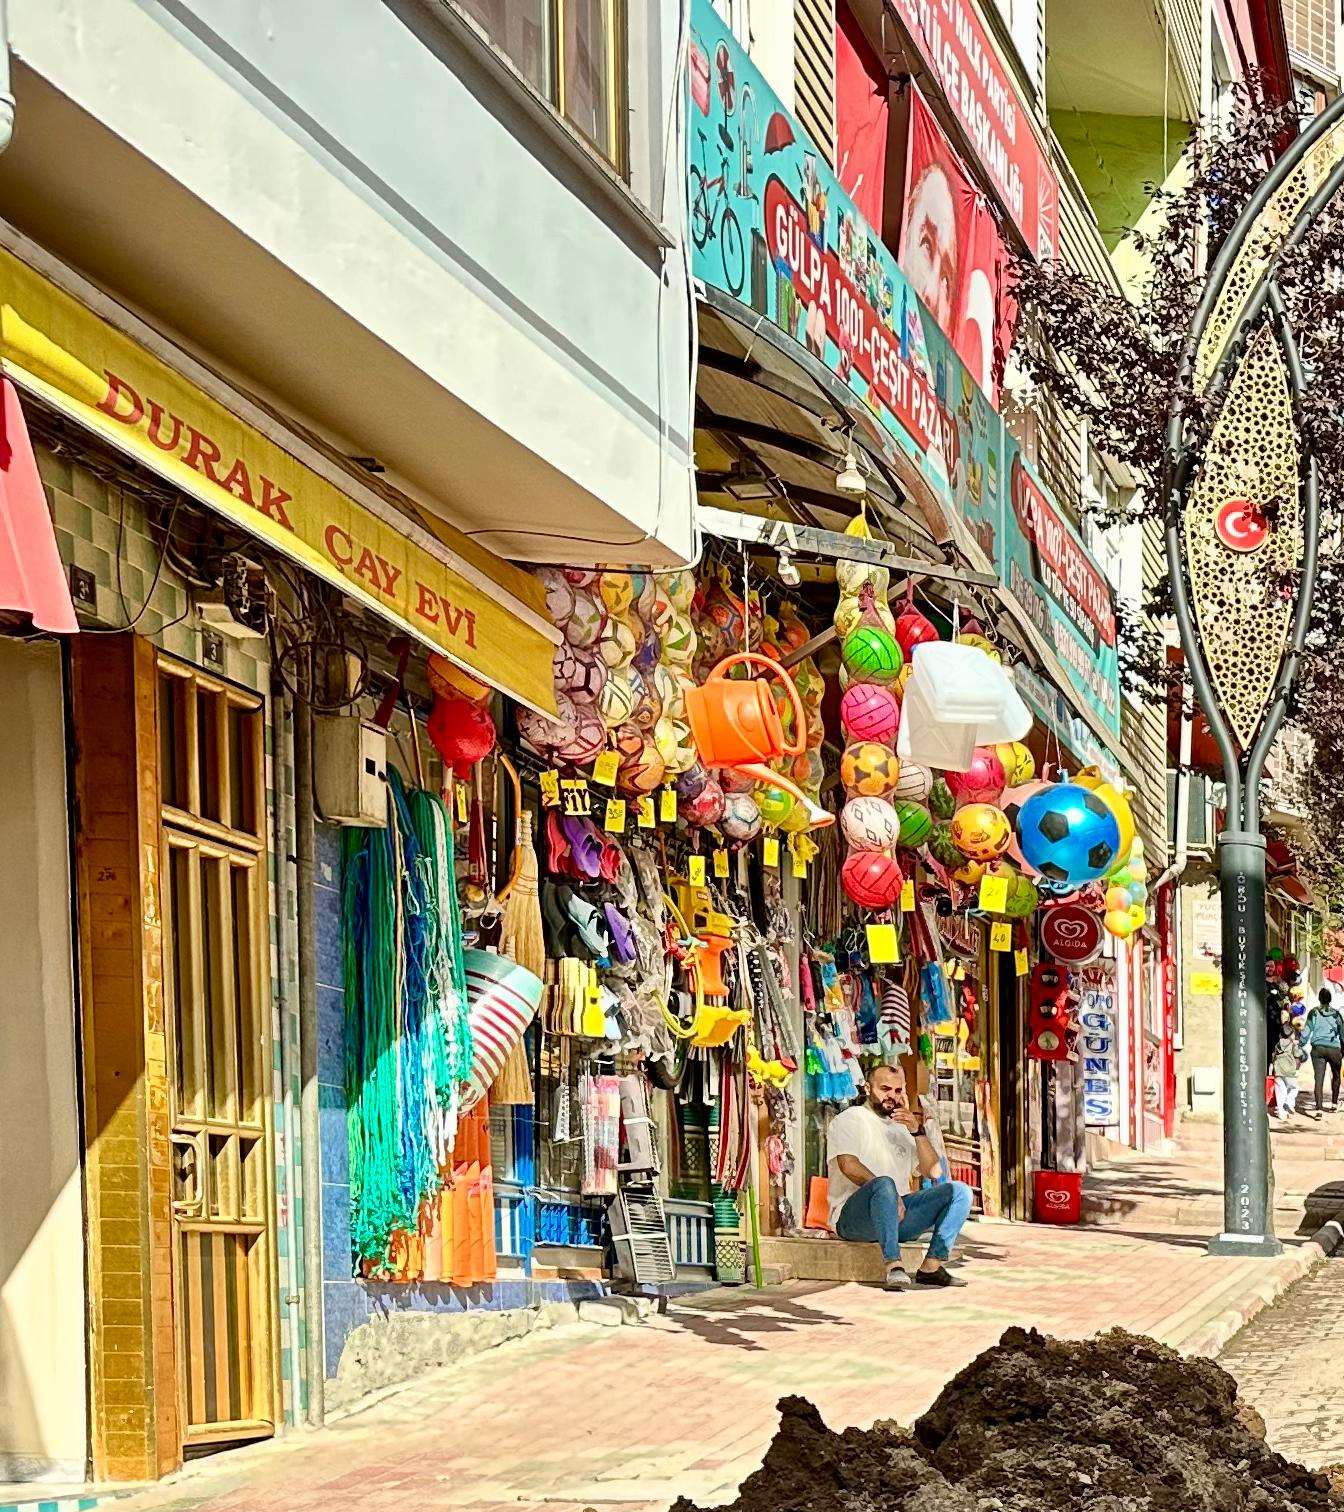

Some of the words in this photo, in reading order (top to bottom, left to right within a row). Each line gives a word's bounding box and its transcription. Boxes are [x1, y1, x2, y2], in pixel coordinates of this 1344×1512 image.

[775, 203, 832, 317] GÜLPA
[911, 382, 955, 469] PAZARI
[96, 369, 295, 532] DURAK
[324, 524, 402, 600] ÇAY
[414, 581, 478, 650] EVİ
